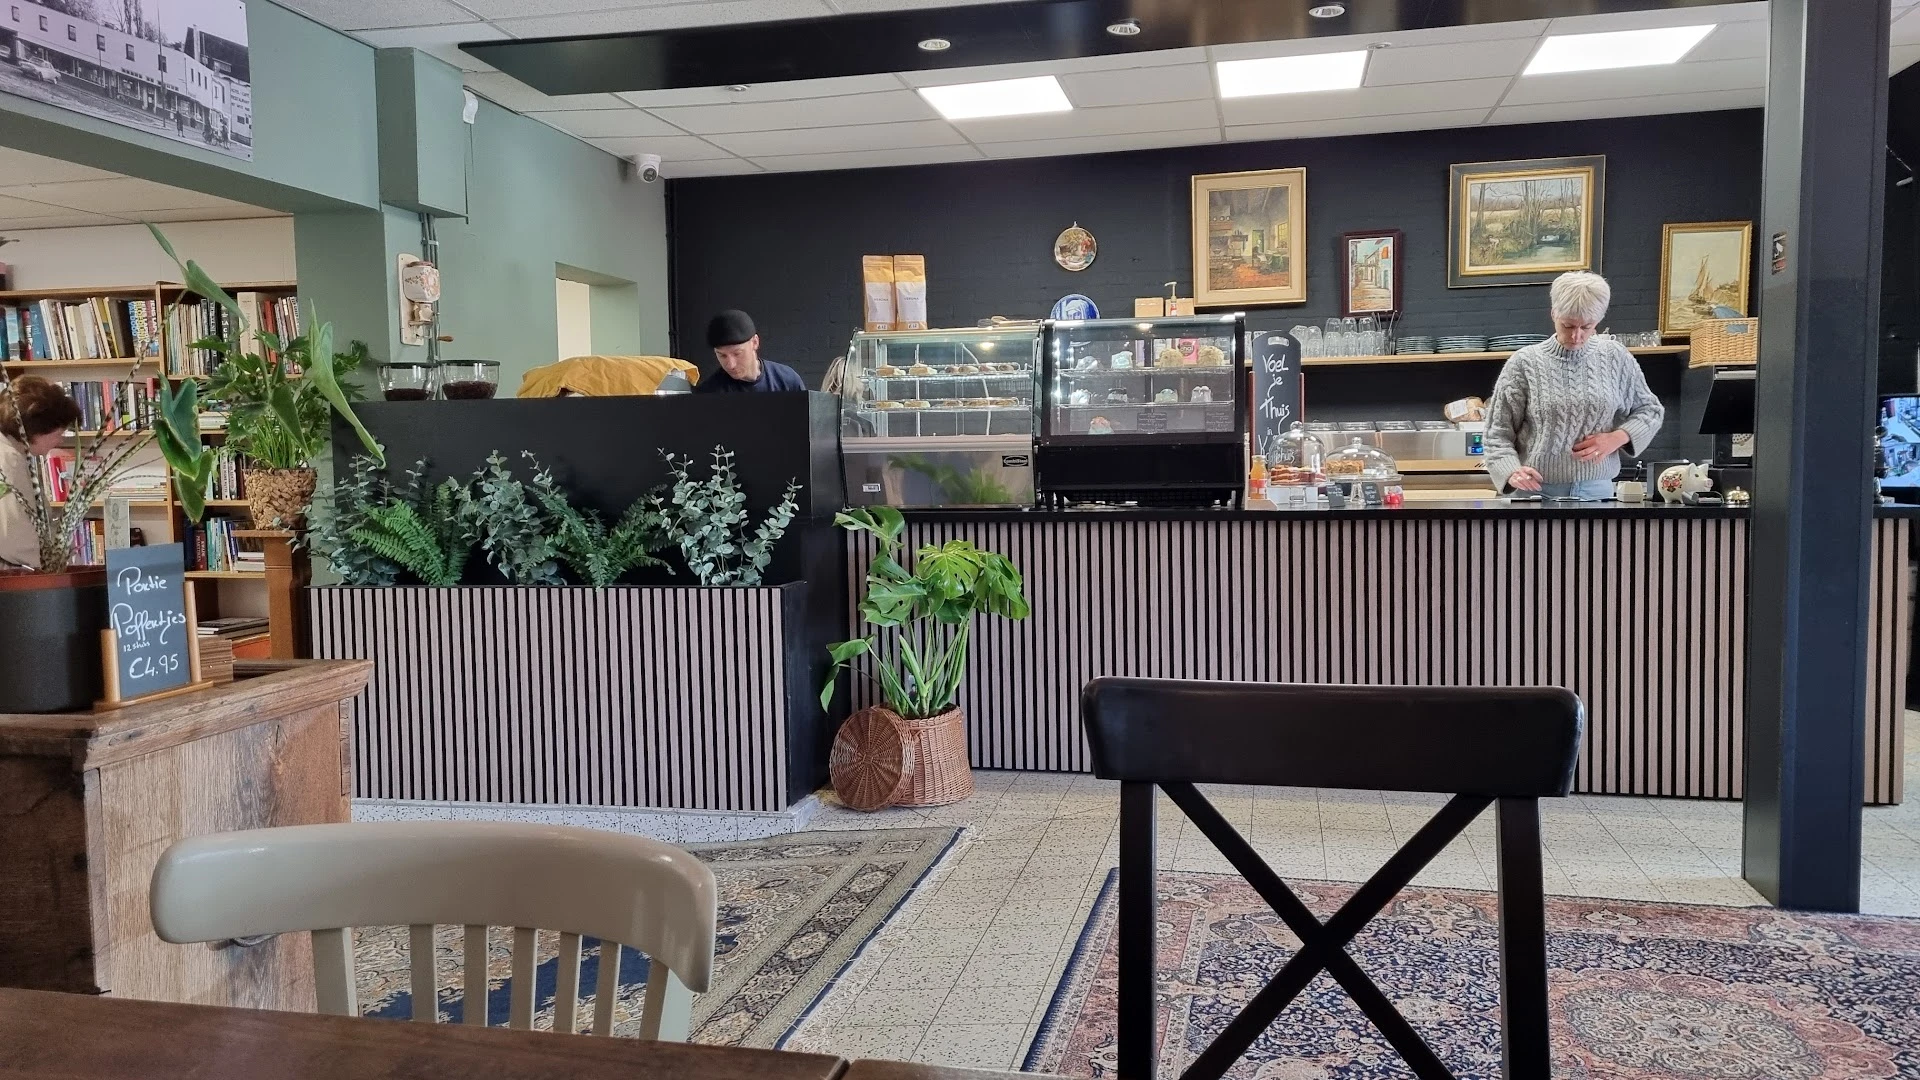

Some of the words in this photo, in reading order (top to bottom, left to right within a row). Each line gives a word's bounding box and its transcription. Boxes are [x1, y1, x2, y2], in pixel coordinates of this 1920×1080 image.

[1259, 396, 1290, 430] Thuis
[117, 566, 167, 596] Portie
[110, 602, 187, 645] Poffertjes
[123, 644, 132, 652] 12
[129, 653, 179, 679] €4.95
